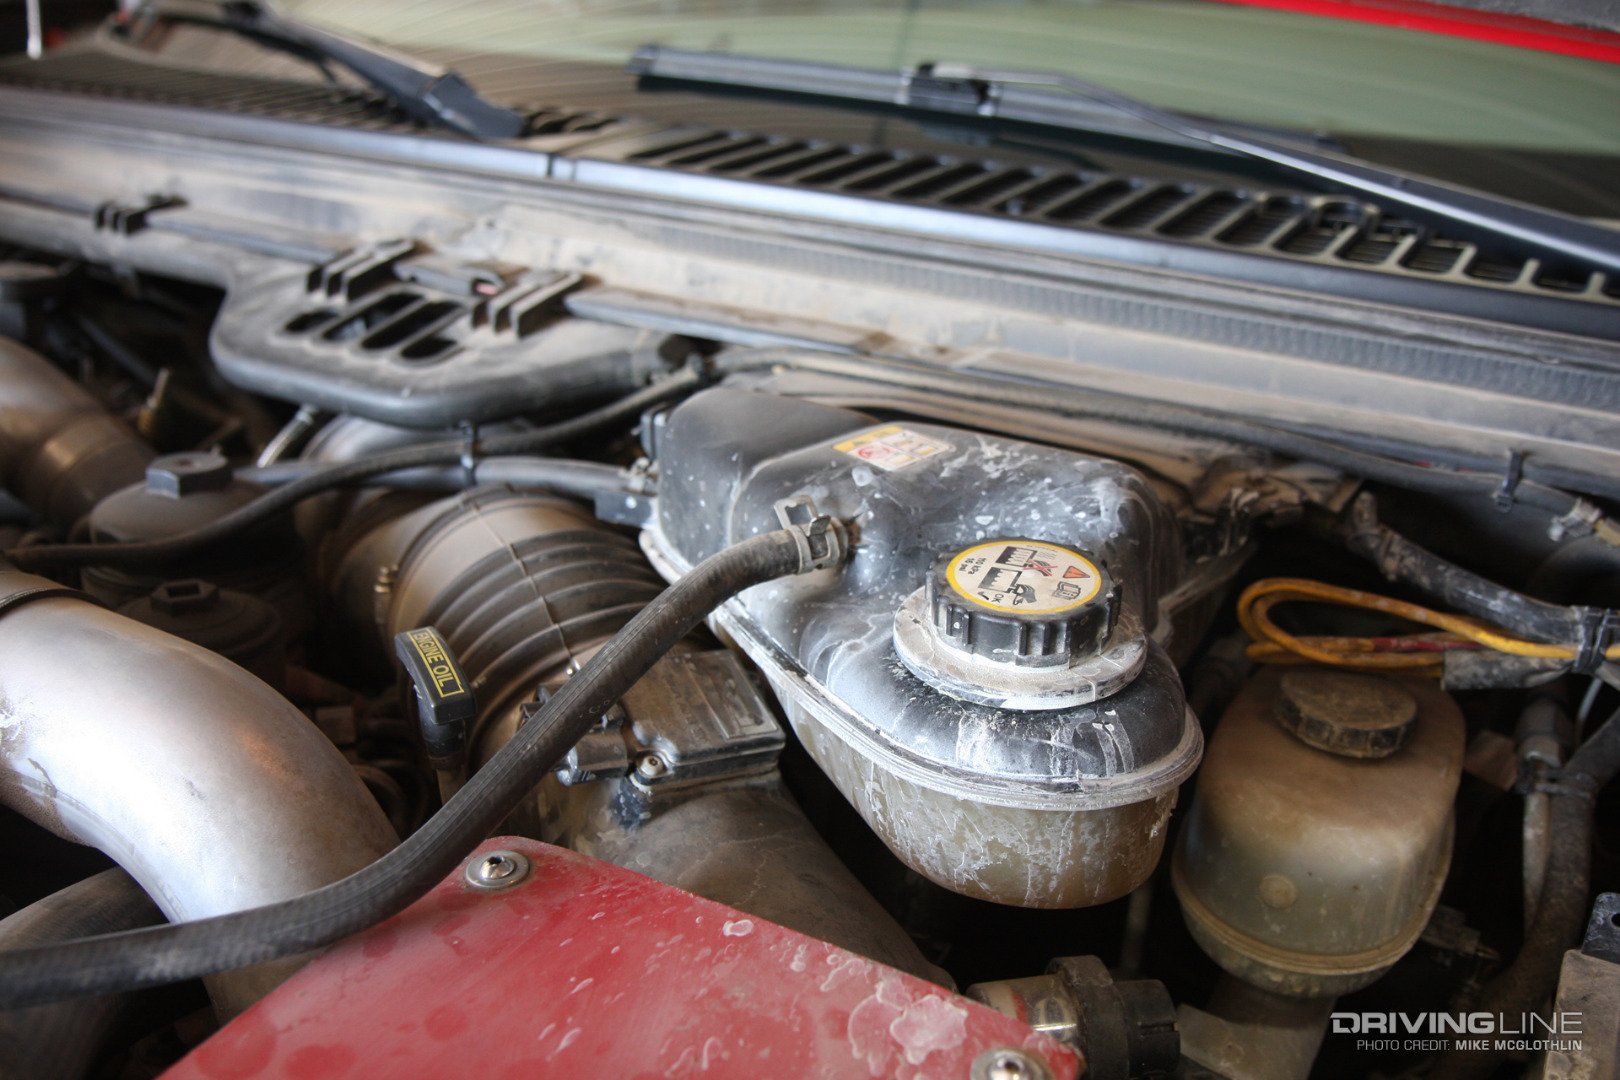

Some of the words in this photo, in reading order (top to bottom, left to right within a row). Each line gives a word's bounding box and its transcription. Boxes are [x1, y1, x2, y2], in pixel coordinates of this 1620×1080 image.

[991, 593, 1004, 603] OK
[413, 631, 445, 664] ENGINE
[432, 665, 454, 687] OIL
